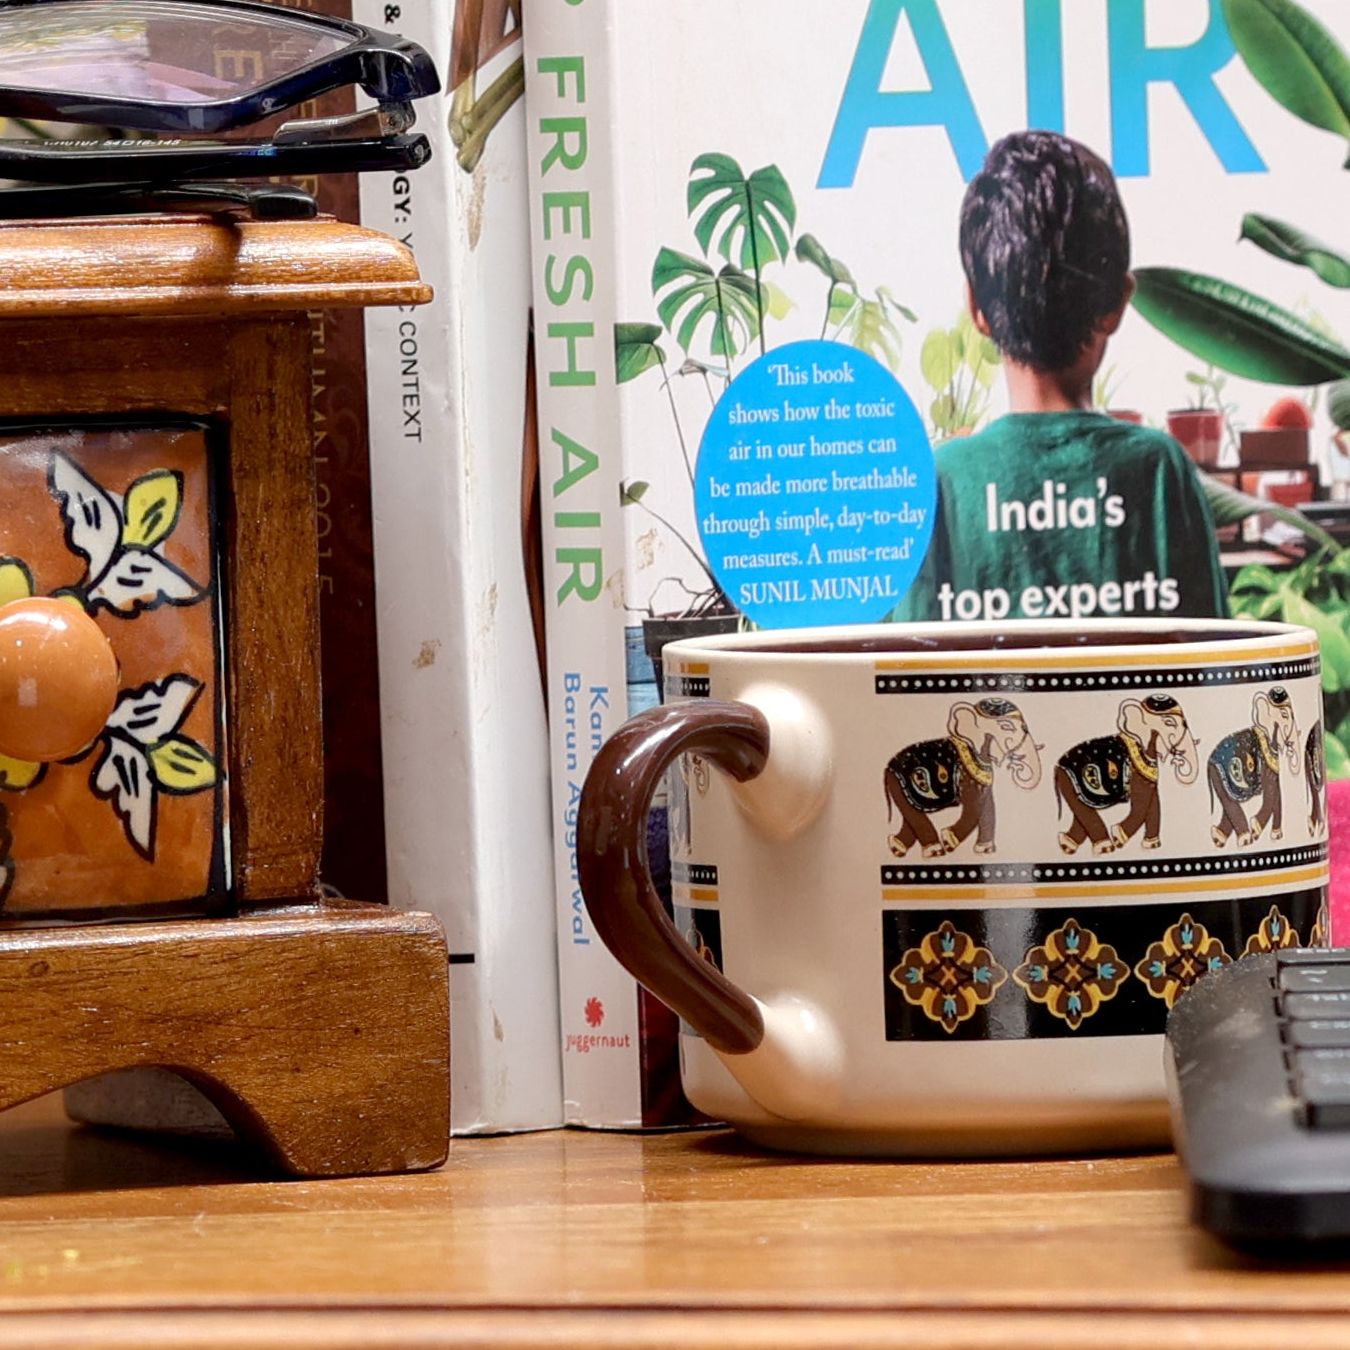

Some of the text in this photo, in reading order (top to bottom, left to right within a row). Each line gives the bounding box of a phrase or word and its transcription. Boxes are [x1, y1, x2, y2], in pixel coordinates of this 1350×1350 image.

[384, 4, 401, 24] &
[536, 56, 605, 607] FRESH AIR
[398, 321, 422, 443] CONTEXT
[812, 362, 855, 384] book
[728, 397, 895, 425] shows how the toxic
[728, 436, 897, 461] air in our homes can
[710, 466, 918, 498] be made more breathable
[985, 476, 1127, 532] India's
[703, 502, 927, 539] through simple, day-to-day
[723, 550, 803, 570] measures.
[807, 543, 823, 565] A
[740, 574, 899, 605] SUNIL MUNJAL
[938, 571, 1181, 620] top experts
[564, 672, 582, 771] Barun
[565, 1032, 630, 1052] juggernaut
